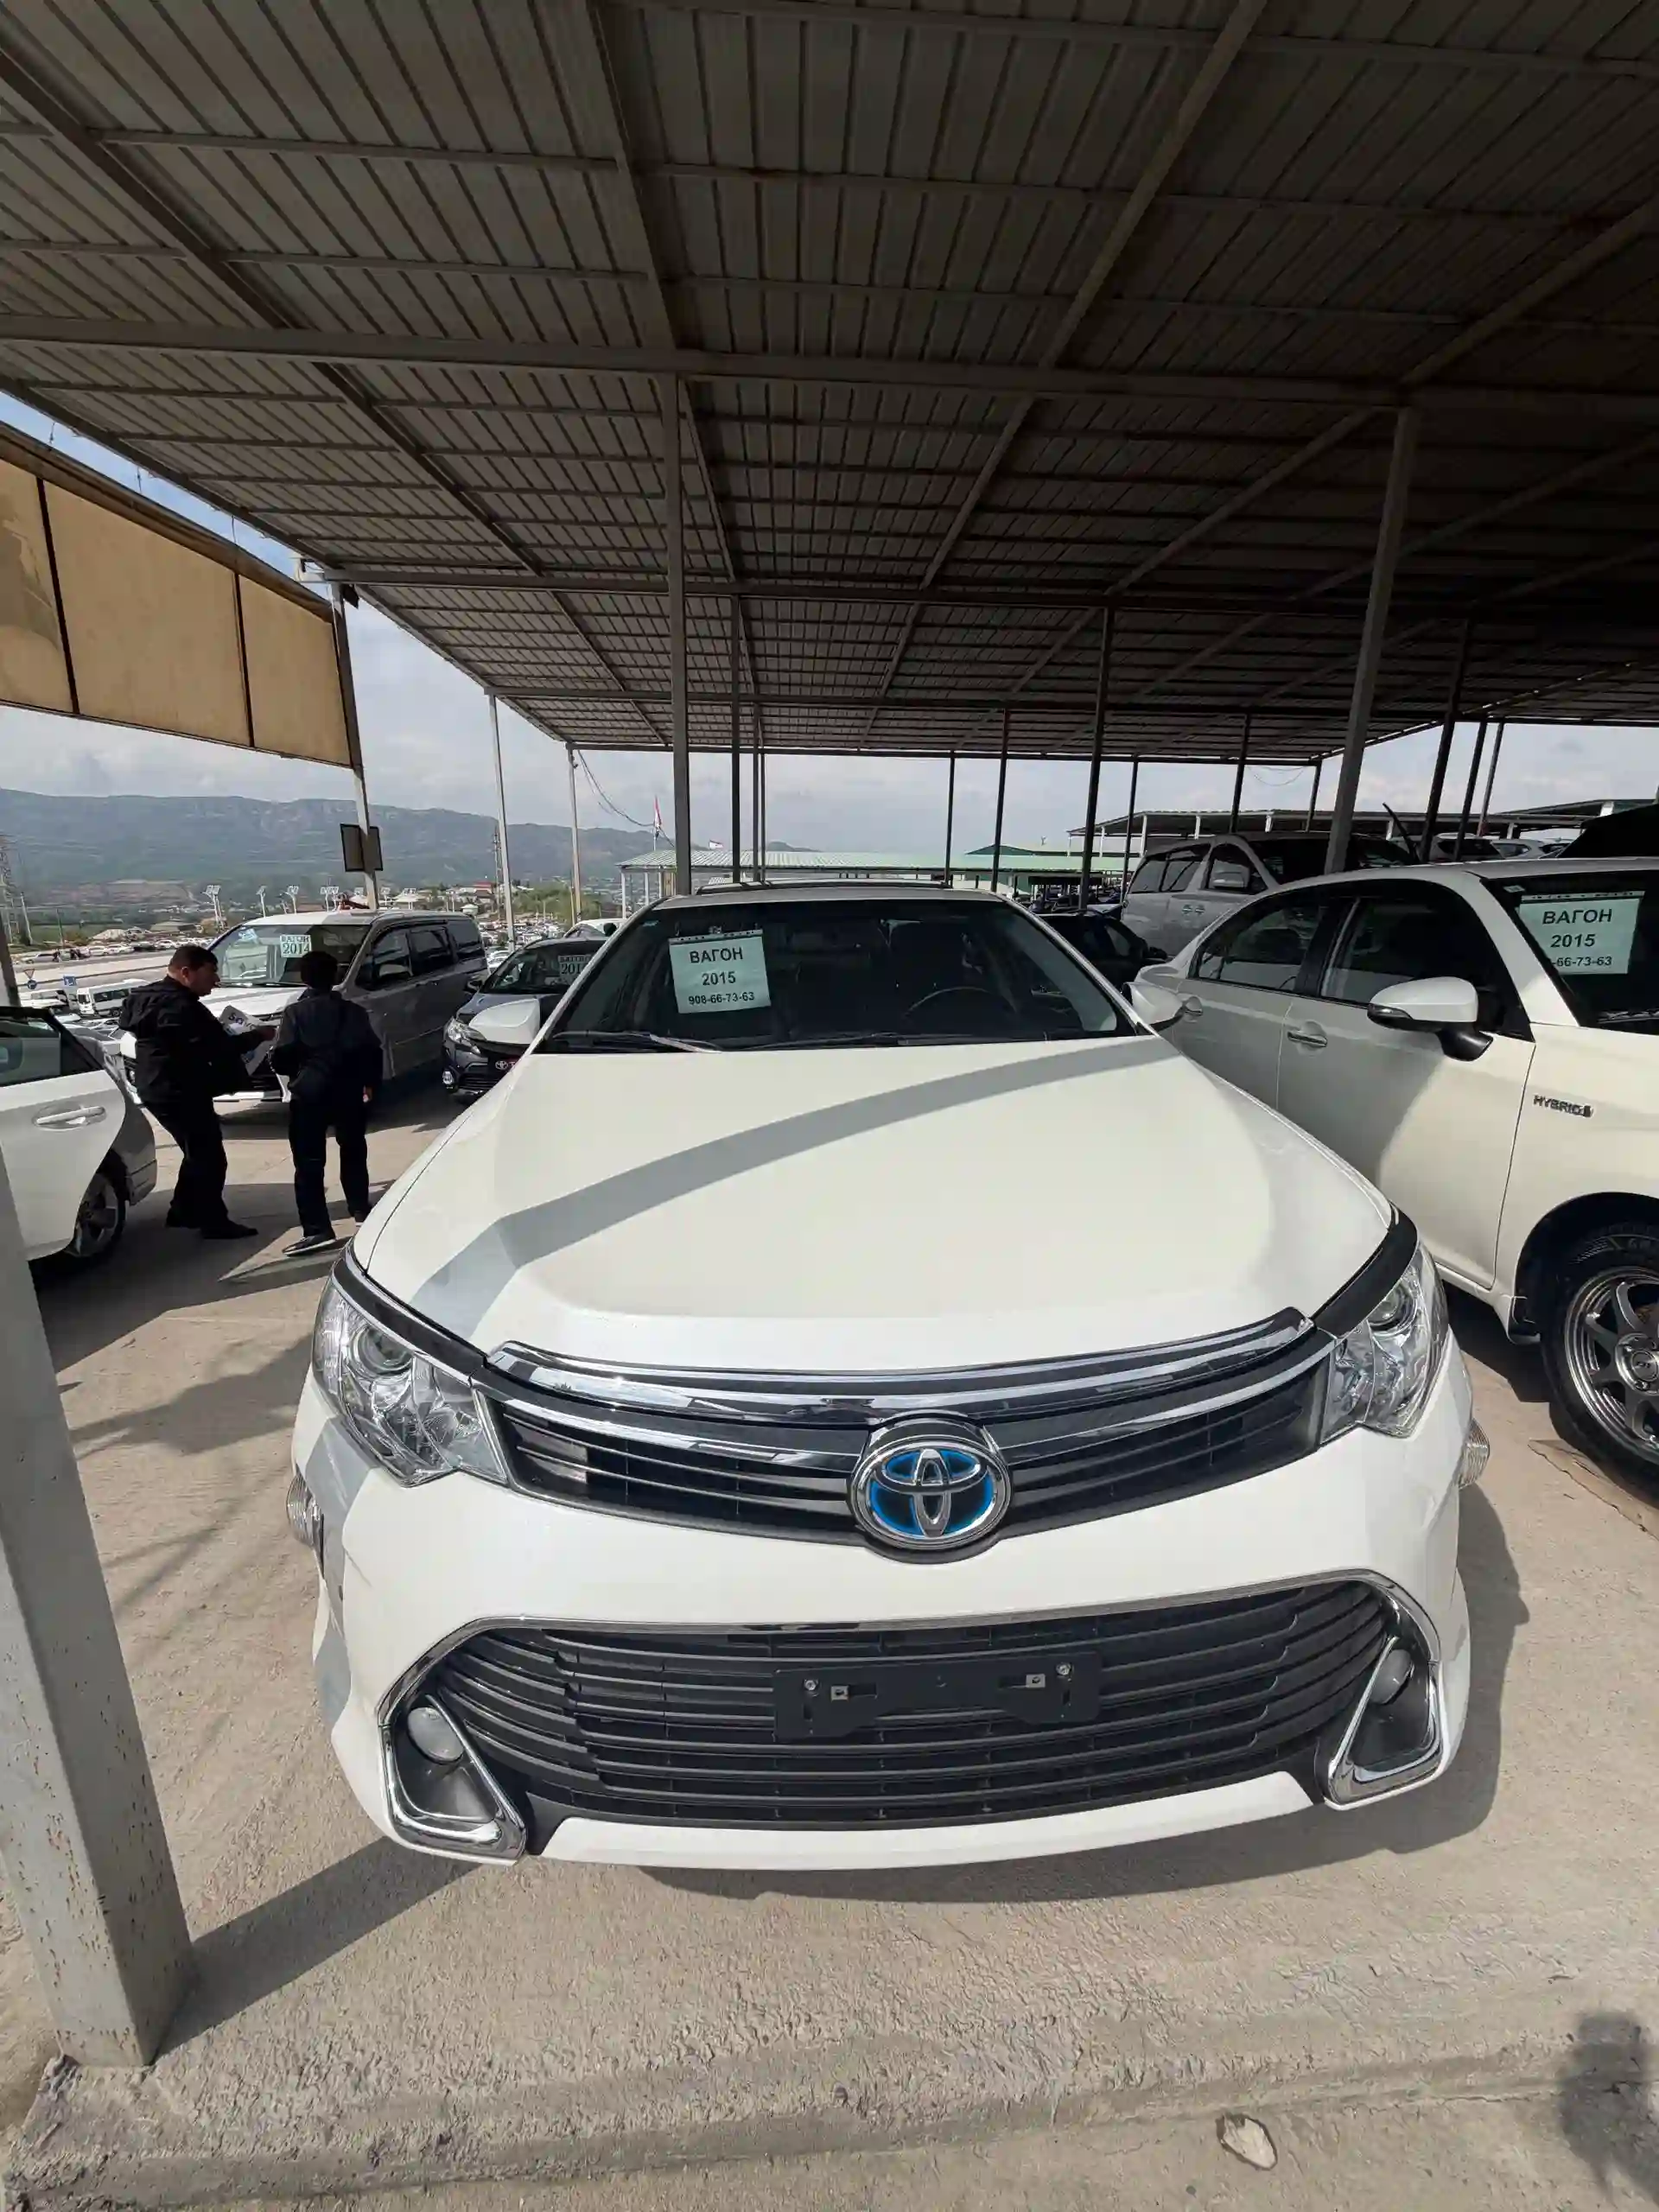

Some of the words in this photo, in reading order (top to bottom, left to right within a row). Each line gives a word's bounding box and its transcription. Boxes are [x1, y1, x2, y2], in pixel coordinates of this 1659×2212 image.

[1542, 909, 1612, 925] ВАГОН
[1550, 934, 1596, 948] 2015
[690, 947, 744, 963] ВАГОН
[1552, 956, 1612, 967] -66-73-63
[562, 963, 582, 975] 201
[702, 971, 736, 986] 2015
[688, 991, 755, 1005] 908-66-73-63
